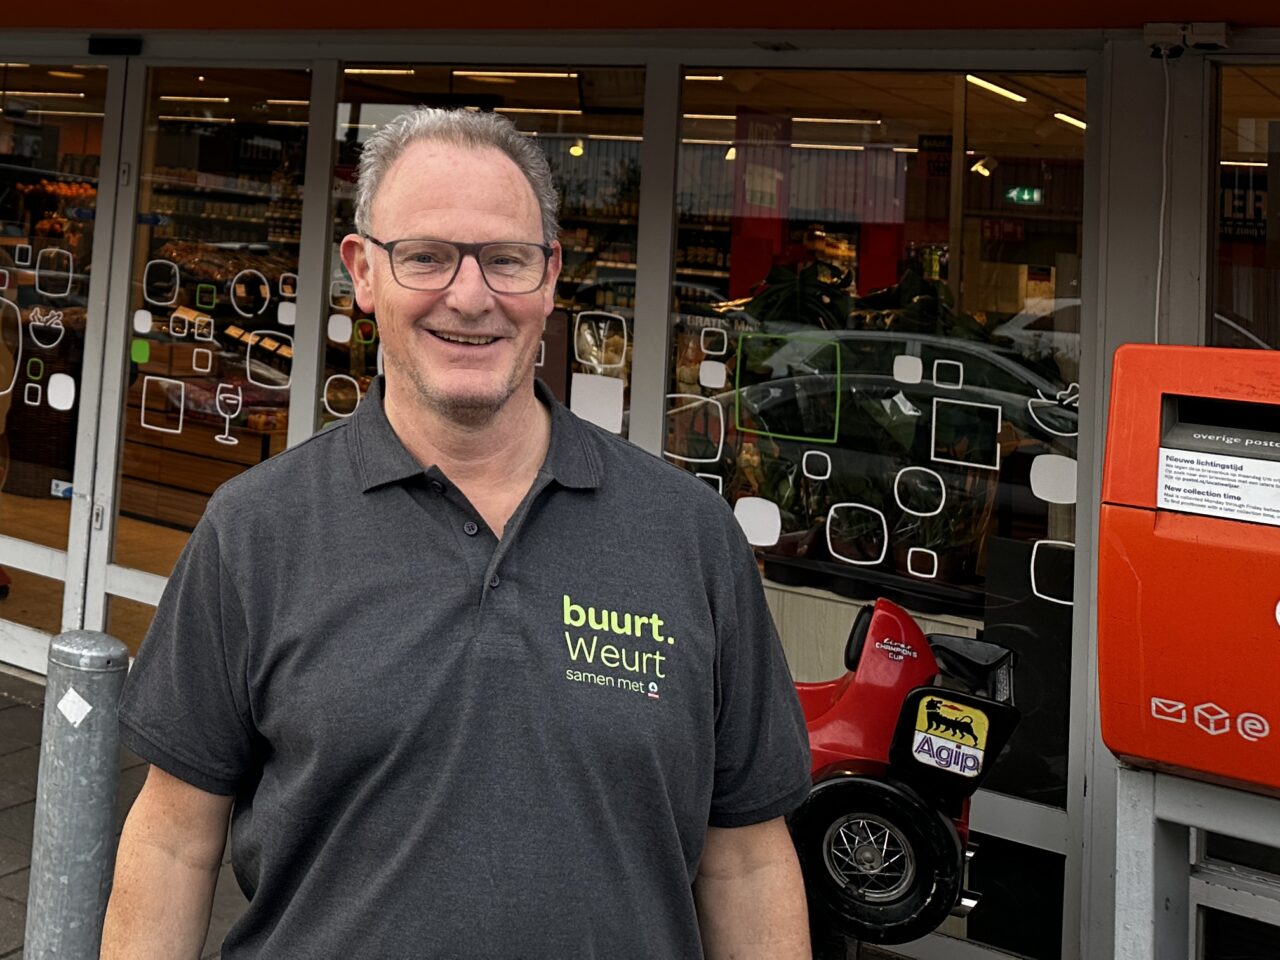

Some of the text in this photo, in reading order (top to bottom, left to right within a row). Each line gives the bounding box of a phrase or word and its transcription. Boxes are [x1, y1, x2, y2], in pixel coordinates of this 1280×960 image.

[1193, 433, 1242, 444] overige
[1166, 455, 1243, 471] Nieuwe lichtingstijd
[1164, 483, 1242, 501] New collection time
[562, 594, 676, 645] buurt.
[564, 631, 666, 678] Weurt
[875, 641, 918, 659] CHAMPIONS
[888, 652, 904, 662] CUP
[566, 669, 646, 694] samen met
[914, 735, 980, 773] Agip
